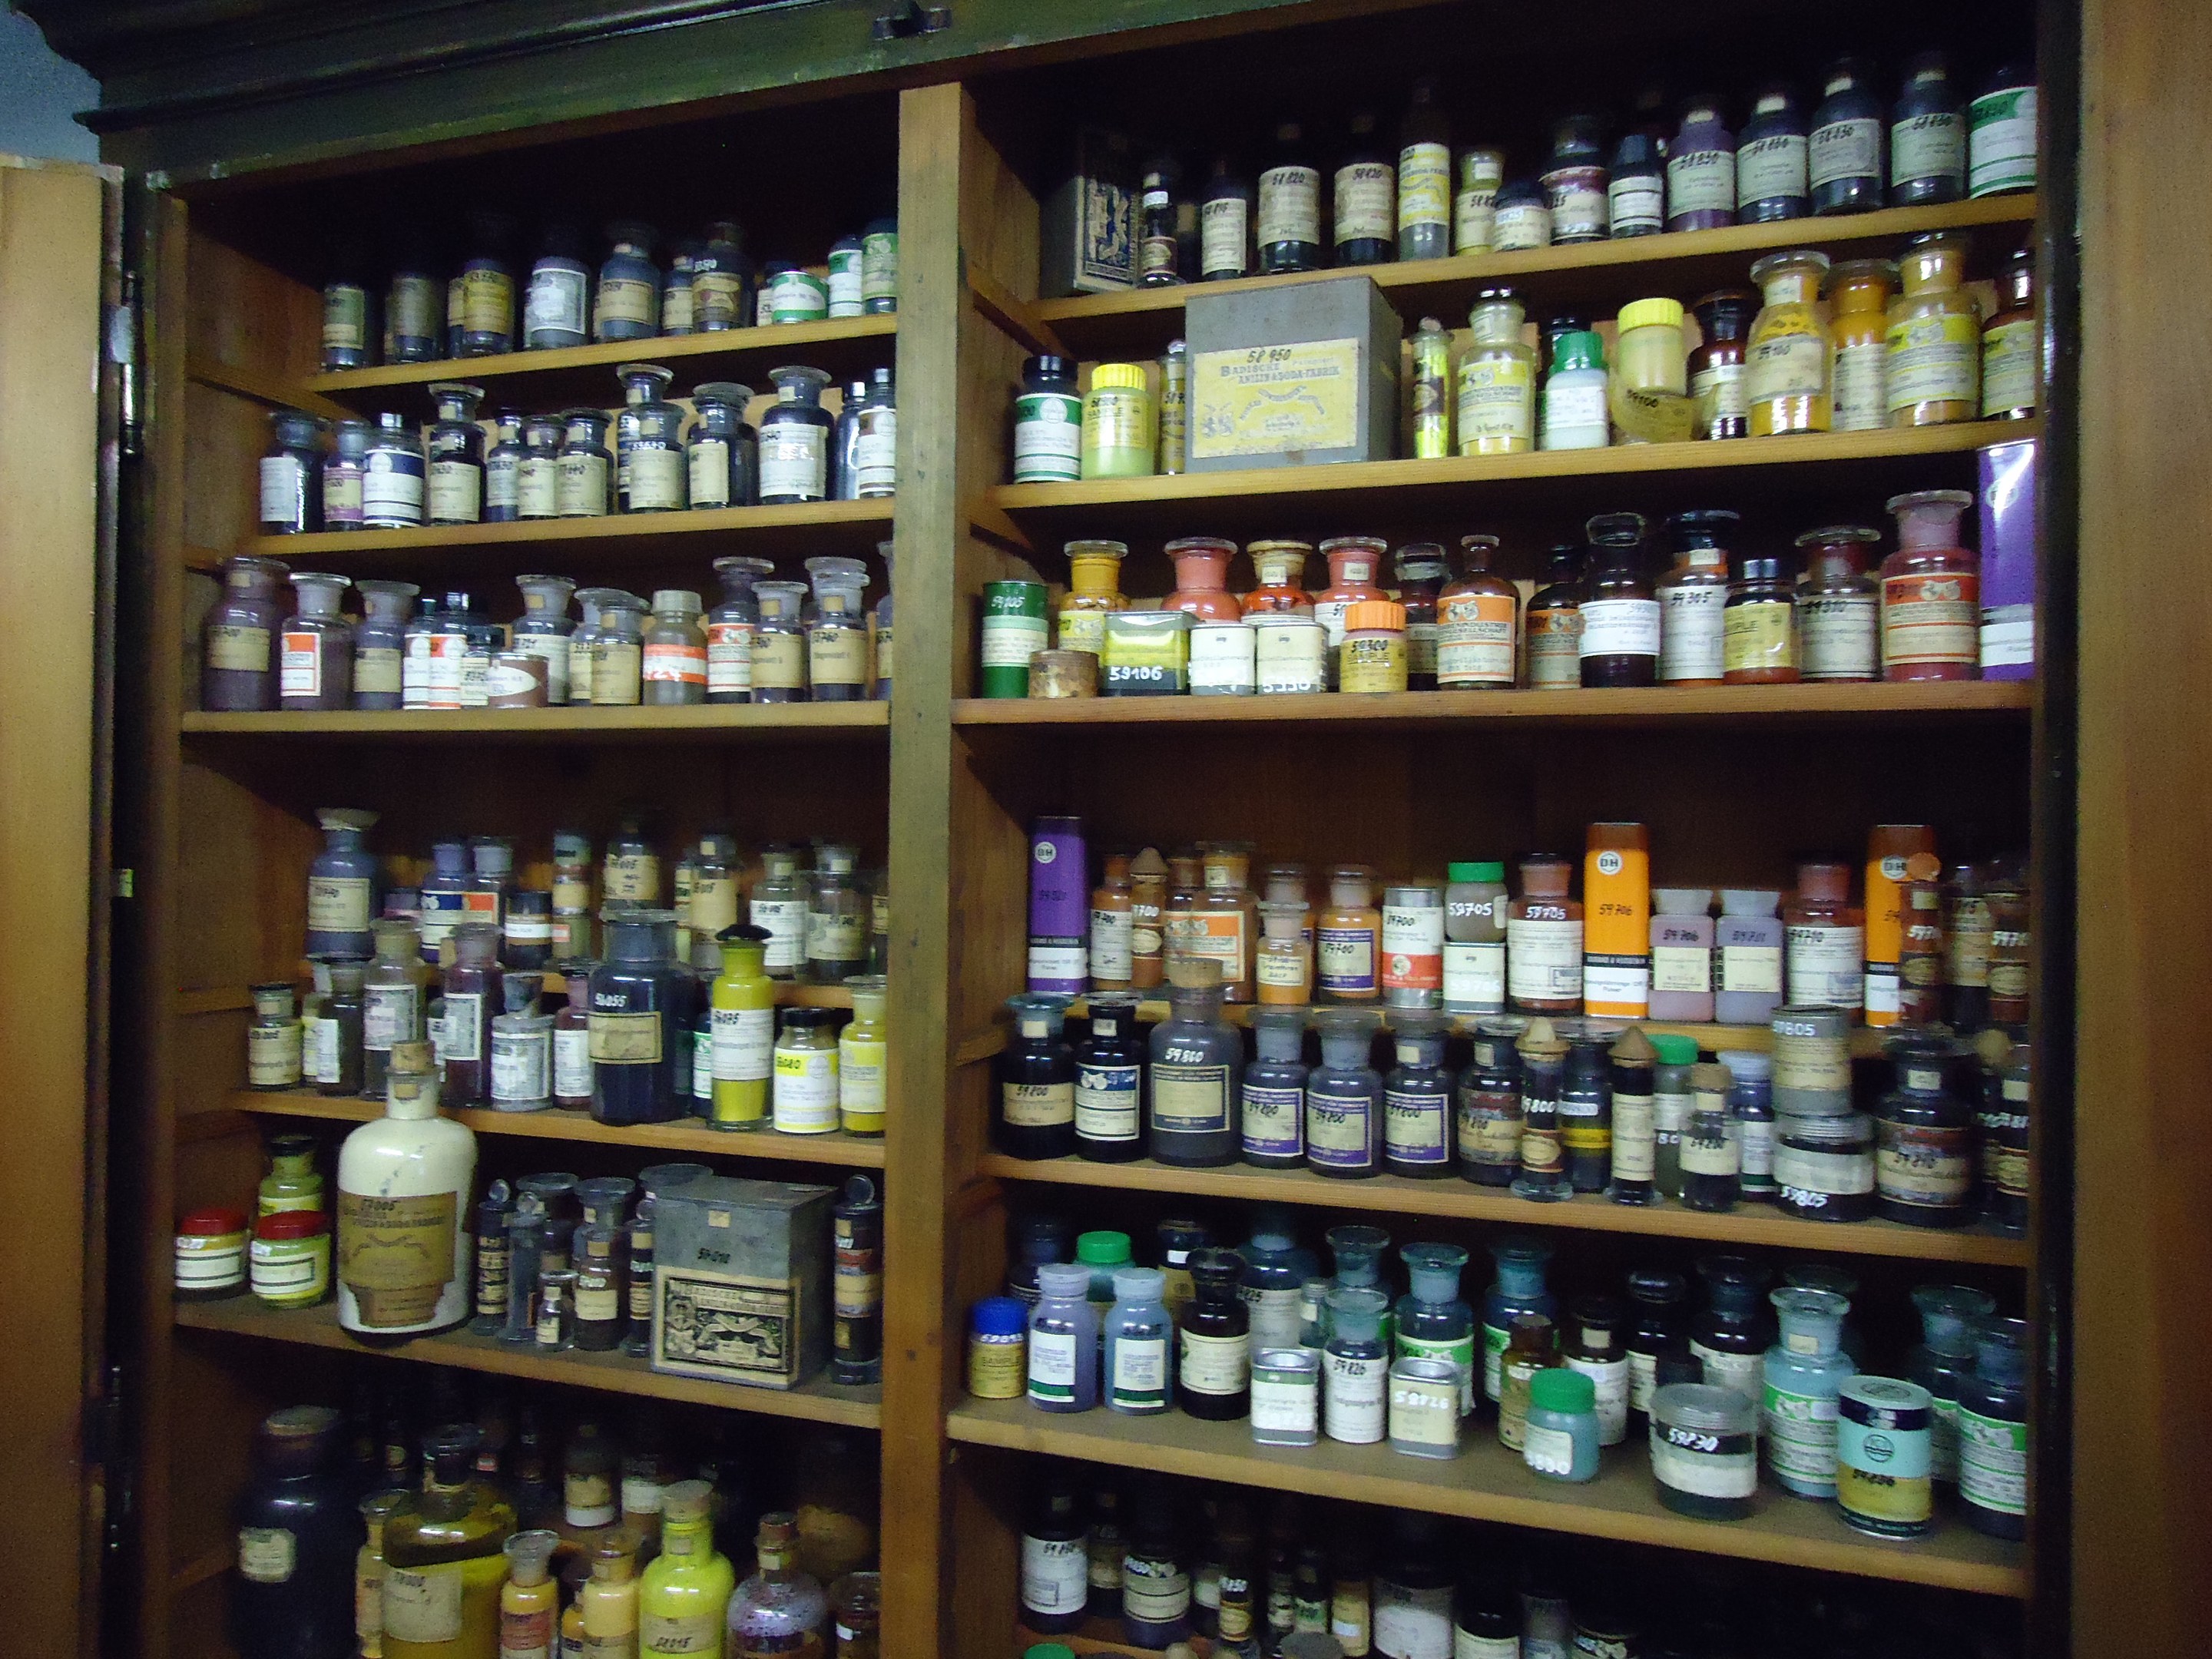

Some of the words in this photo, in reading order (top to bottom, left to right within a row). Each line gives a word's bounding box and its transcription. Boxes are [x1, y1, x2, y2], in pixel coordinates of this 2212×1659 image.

[1269, 349, 1292, 363] 950
[1221, 363, 1280, 377] BADISCHE
[1108, 665, 1164, 681] 59106
[1449, 902, 1493, 917] 59705
[1525, 906, 1567, 920] 59705
